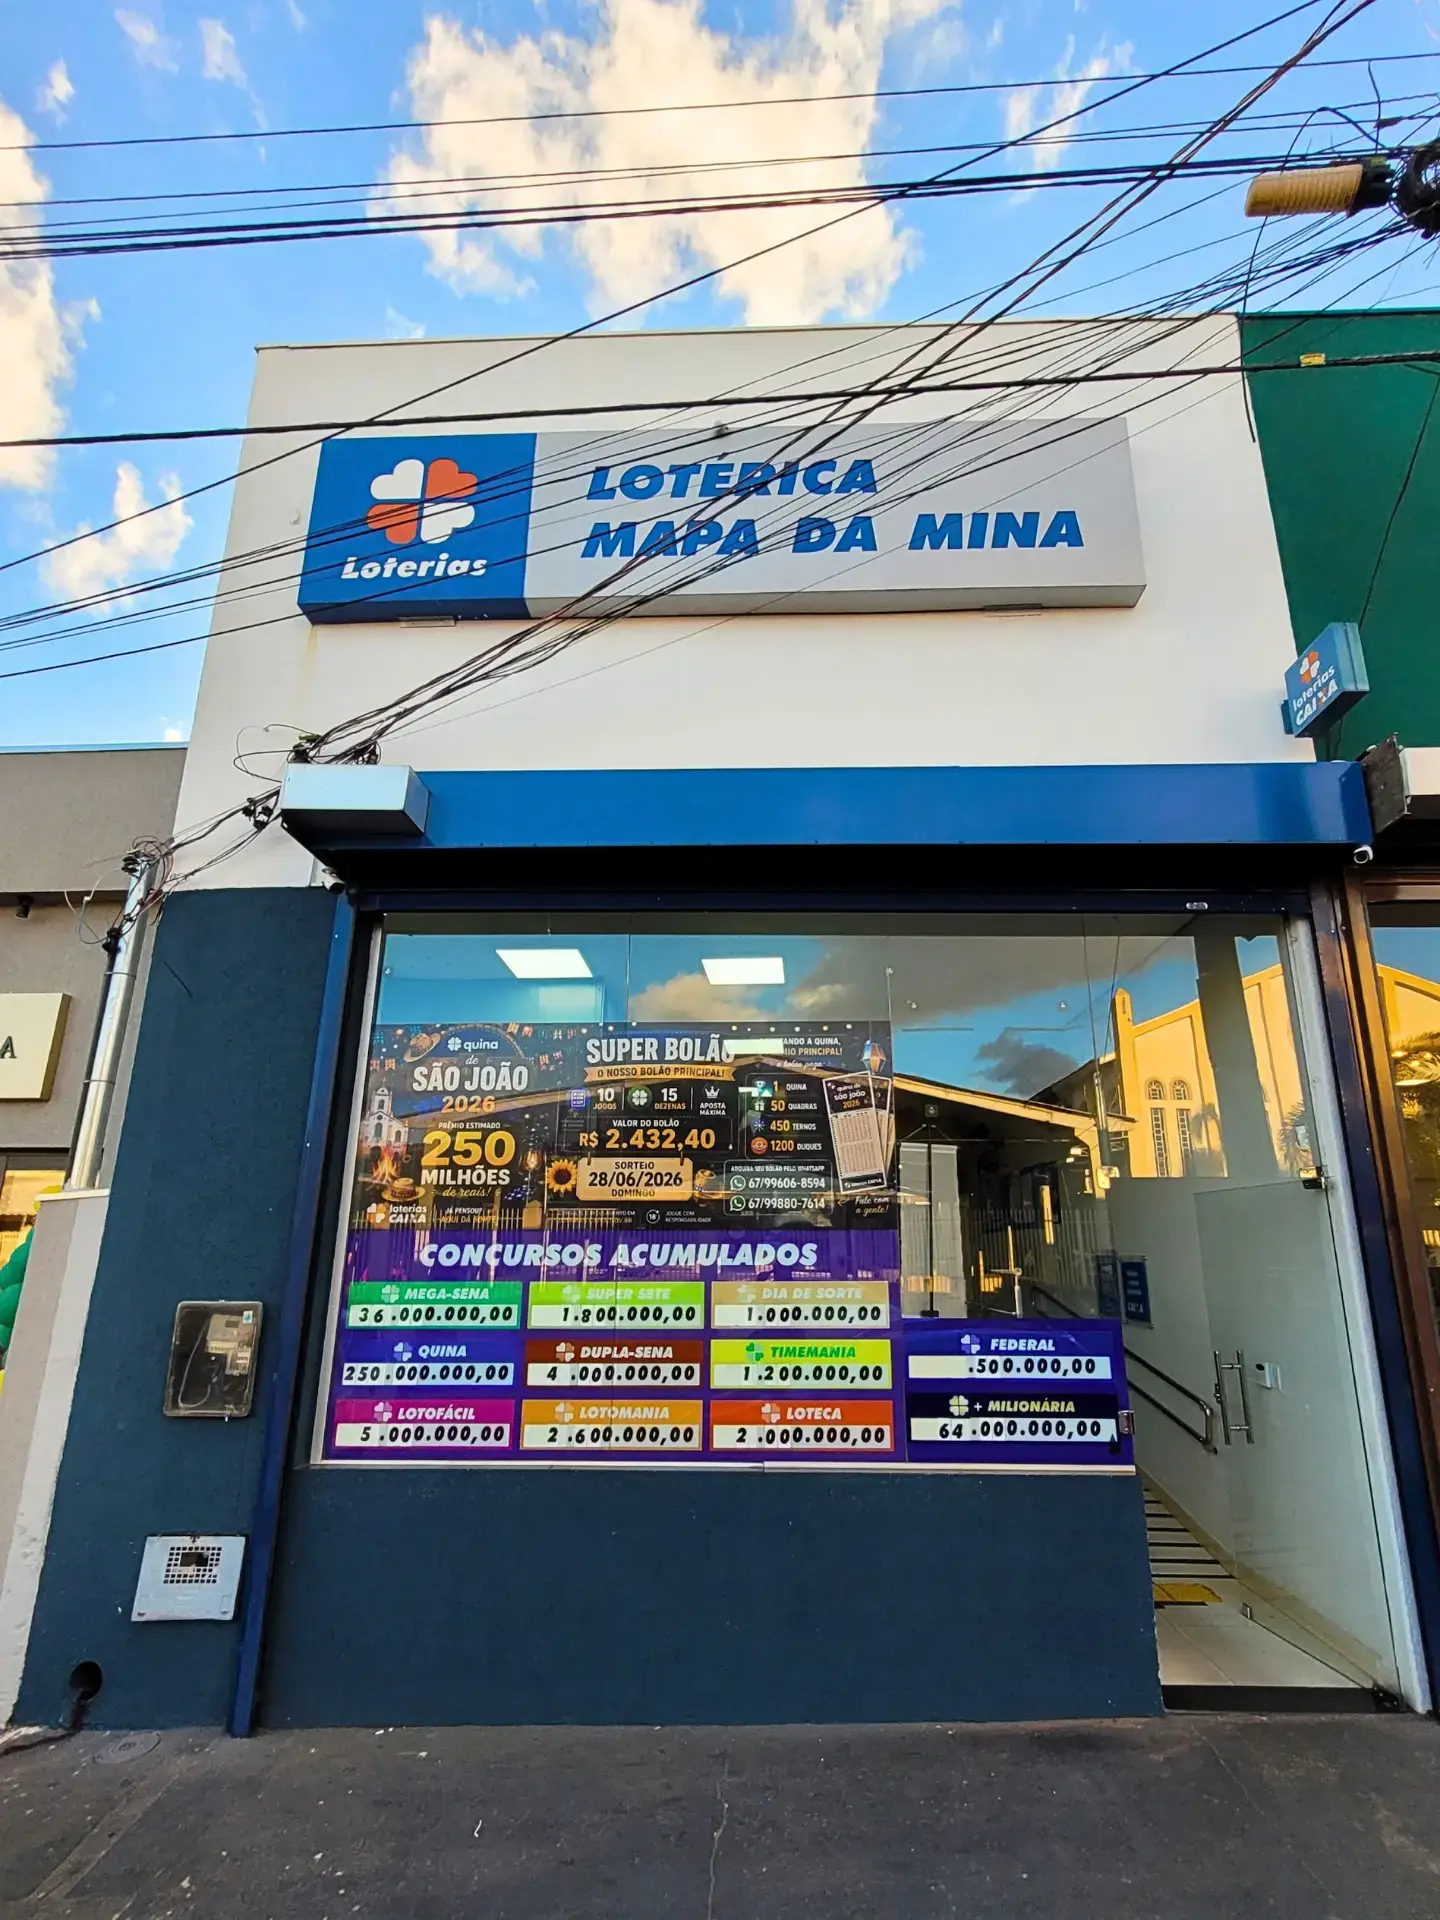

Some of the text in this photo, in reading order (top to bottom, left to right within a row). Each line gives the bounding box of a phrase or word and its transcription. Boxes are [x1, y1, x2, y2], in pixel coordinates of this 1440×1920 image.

[586, 452, 878, 500] LOTÉRICA
[580, 510, 1084, 559] MAPA DA MINA
[341, 553, 487, 580] Loterias
[1293, 665, 1335, 711] loterias
[1296, 679, 1337, 726] CAIXA
[463, 1040, 498, 1052] quina
[814, 1037, 841, 1046] QUINA,
[586, 1037, 658, 1064] SUPER
[798, 1047, 843, 1056] PRINCIPAL!
[466, 1055, 480, 1065] de
[412, 1062, 528, 1092] SÃO JOÃO
[597, 1066, 725, 1078] O NOSSO BOLÃO PRINCIPAL!
[773, 1080, 807, 1092] 1 QUINA
[597, 1087, 615, 1101] 10
[661, 1087, 678, 1101] 15
[441, 1095, 496, 1113] 2026
[654, 1102, 686, 1110] DEZENAS
[700, 1102, 726, 1110] APOSTA
[771, 1100, 785, 1111] 50
[438, 1121, 500, 1129] PRÊMIO ESTIMADO
[654, 1118, 680, 1127] BOLÃO
[770, 1120, 790, 1131] 450
[580, 1128, 715, 1151] R$ 2.432,40
[770, 1140, 822, 1151] 1200 DUQUES
[421, 1131, 516, 1166] 250
[614, 1161, 654, 1170] SORTEIO
[420, 1165, 510, 1185] MILHÕES
[588, 1171, 683, 1188] 28/06/2026
[748, 1177, 826, 1189] 67/99606-8594
[442, 1187, 457, 1197] de
[611, 1188, 655, 1198] DOMINGO
[389, 1204, 427, 1213] loterias
[748, 1198, 825, 1209] 67/99880-7614
[389, 1214, 426, 1224] CAIXA
[420, 1243, 818, 1267] CONCURSOS ACUMULADOS
[404, 1287, 489, 1300] MEGA-SENA
[586, 1287, 671, 1300] SUPER SETE
[762, 1287, 862, 1300] DIA DE SORTE
[359, 1305, 513, 1324] 36.000.000,00
[562, 1305, 696, 1324] 1.800.000,00
[747, 1305, 881, 1324] 1.000.000,00
[418, 1344, 467, 1358] QUINA
[990, 1338, 1055, 1351] FEDERAL
[580, 1346, 673, 1358] DUPLA-SENA
[770, 1346, 856, 1358] TIMEMANIA
[344, 1364, 509, 1383] 250.000.000,00
[969, 1357, 1096, 1376] .500.000,00
[547, 1365, 695, 1383] 4.000.000,00
[743, 1365, 883, 1384] 1.200.000,00
[397, 1404, 476, 1420] LOTOFÁCIL
[987, 1398, 1075, 1412] MILIONÁRIA
[579, 1406, 670, 1420] LOTOMANIA
[786, 1407, 842, 1420] LOTECA
[360, 1425, 505, 1444] 5.000.000,00
[547, 1426, 694, 1445] 2.600.000,00
[736, 1426, 885, 1446] 2.000.000,00
[939, 1419, 1101, 1439] 64.000.000,00
